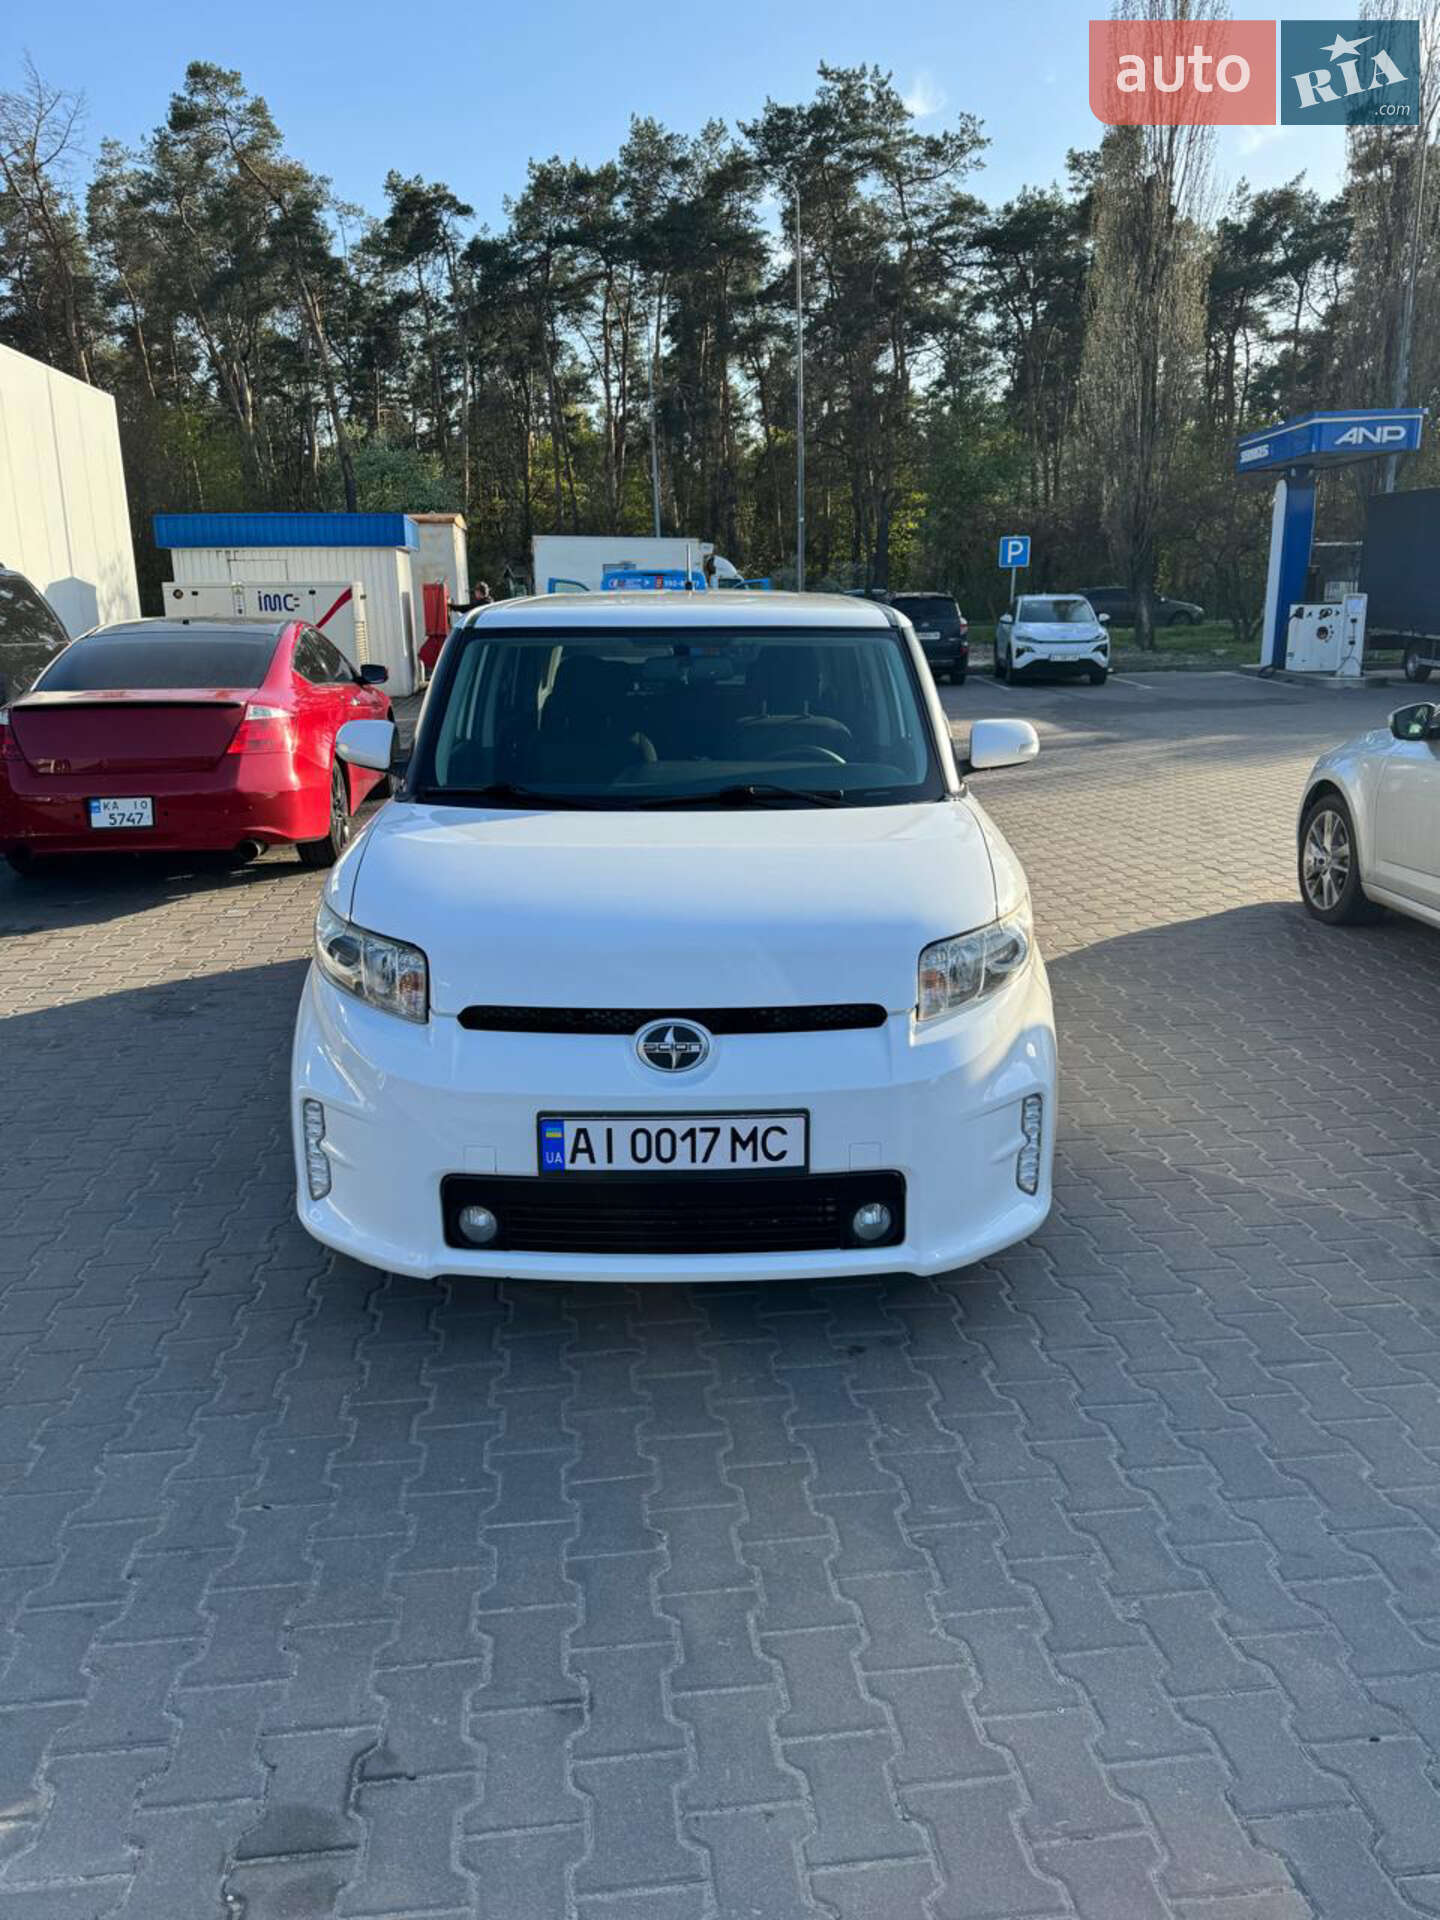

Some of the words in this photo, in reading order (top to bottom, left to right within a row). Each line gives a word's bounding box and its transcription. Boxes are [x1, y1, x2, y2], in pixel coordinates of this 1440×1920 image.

[1334, 426, 1407, 445] ANP
[1007, 540, 1024, 563] P
[103, 801, 119, 811] KA
[109, 812, 144, 825] 5747
[569, 1127, 613, 1164] AI
[630, 1127, 721, 1164] 0017
[730, 1126, 788, 1162] MC
[546, 1152, 563, 1164] UA
